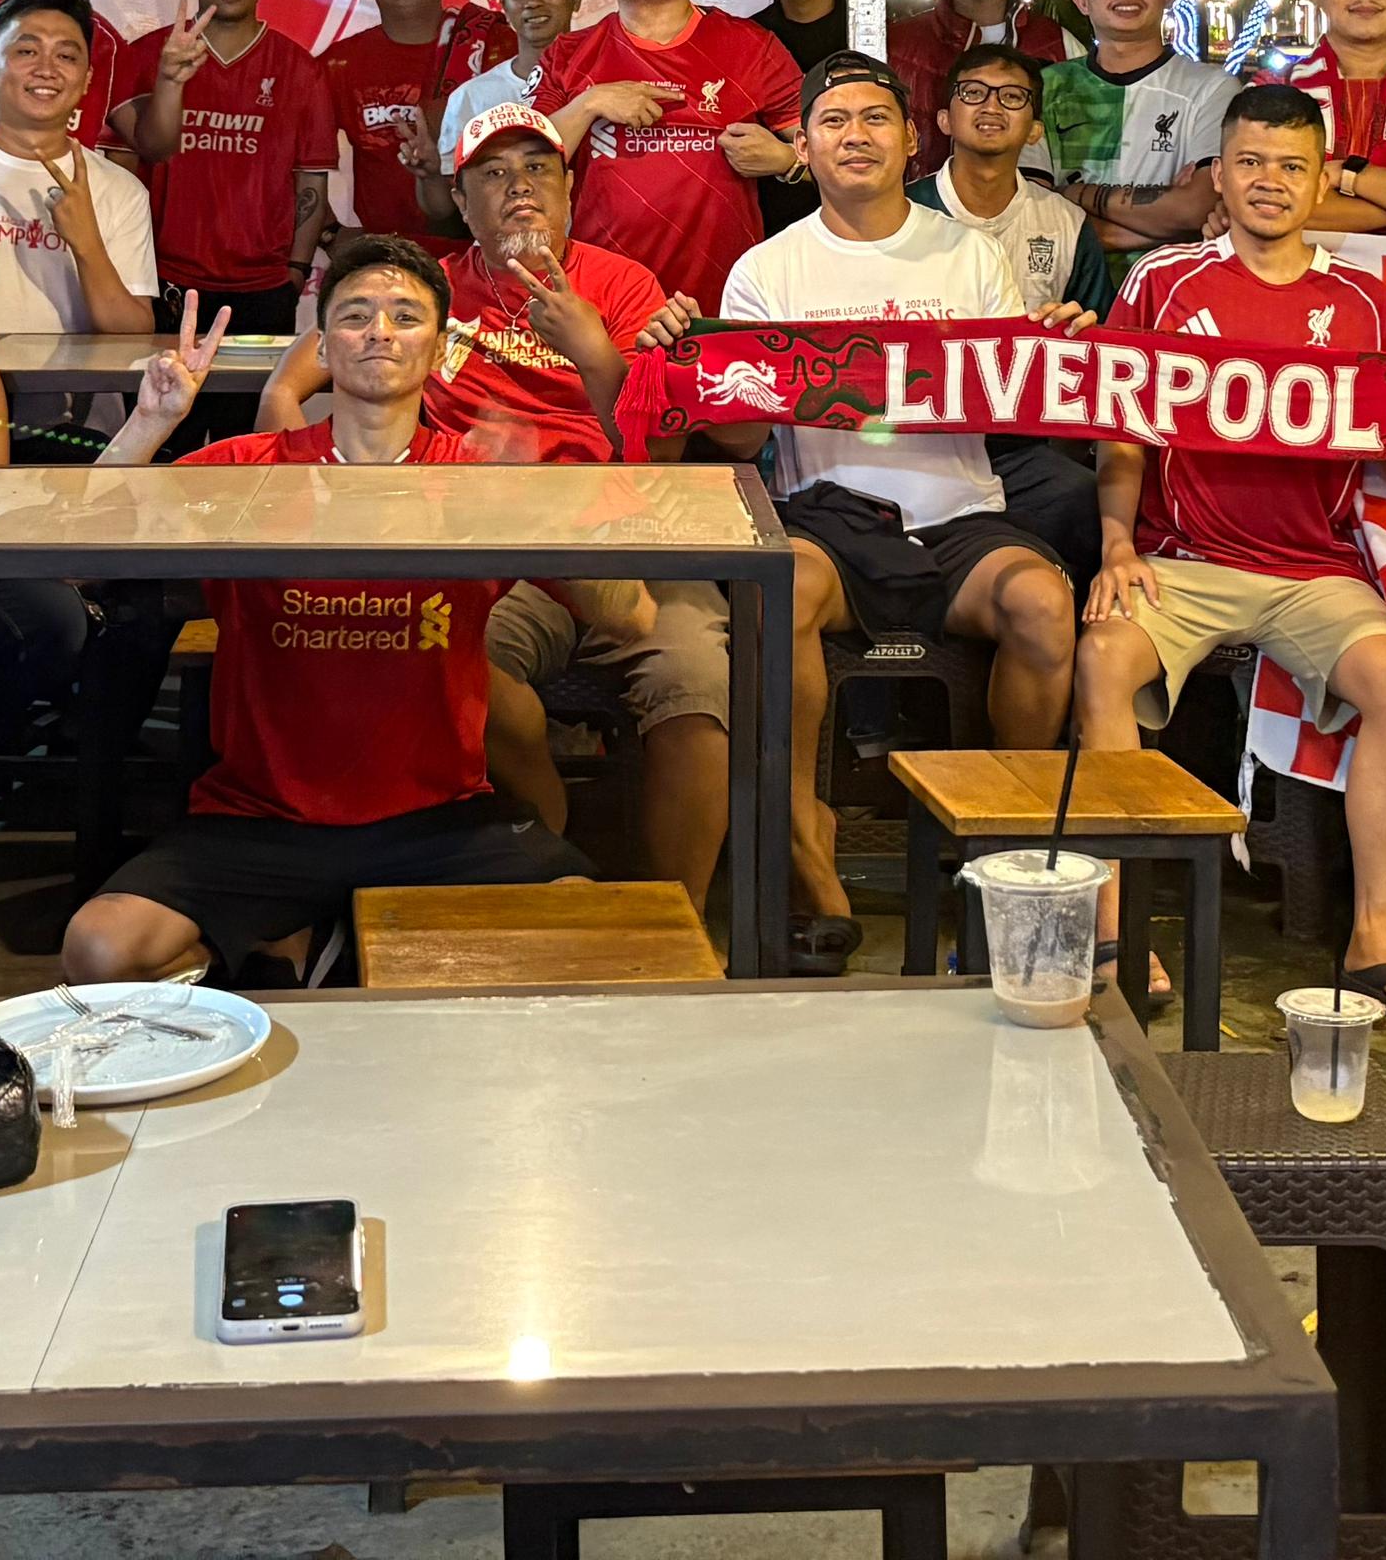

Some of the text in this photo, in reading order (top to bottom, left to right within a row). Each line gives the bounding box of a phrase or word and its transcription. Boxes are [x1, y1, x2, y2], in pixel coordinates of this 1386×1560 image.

[182, 109, 265, 133] crown
[520, 111, 547, 130] 96
[181, 131, 258, 154] paints
[625, 136, 715, 153] chartered
[804, 307, 841, 319] PREMIER
[844, 304, 880, 316] LEAGUE
[905, 298, 942, 309] 2024/25
[881, 337, 1384, 450] LIVERPOOL
[282, 589, 411, 617] Standard
[271, 622, 411, 650] Chartered
